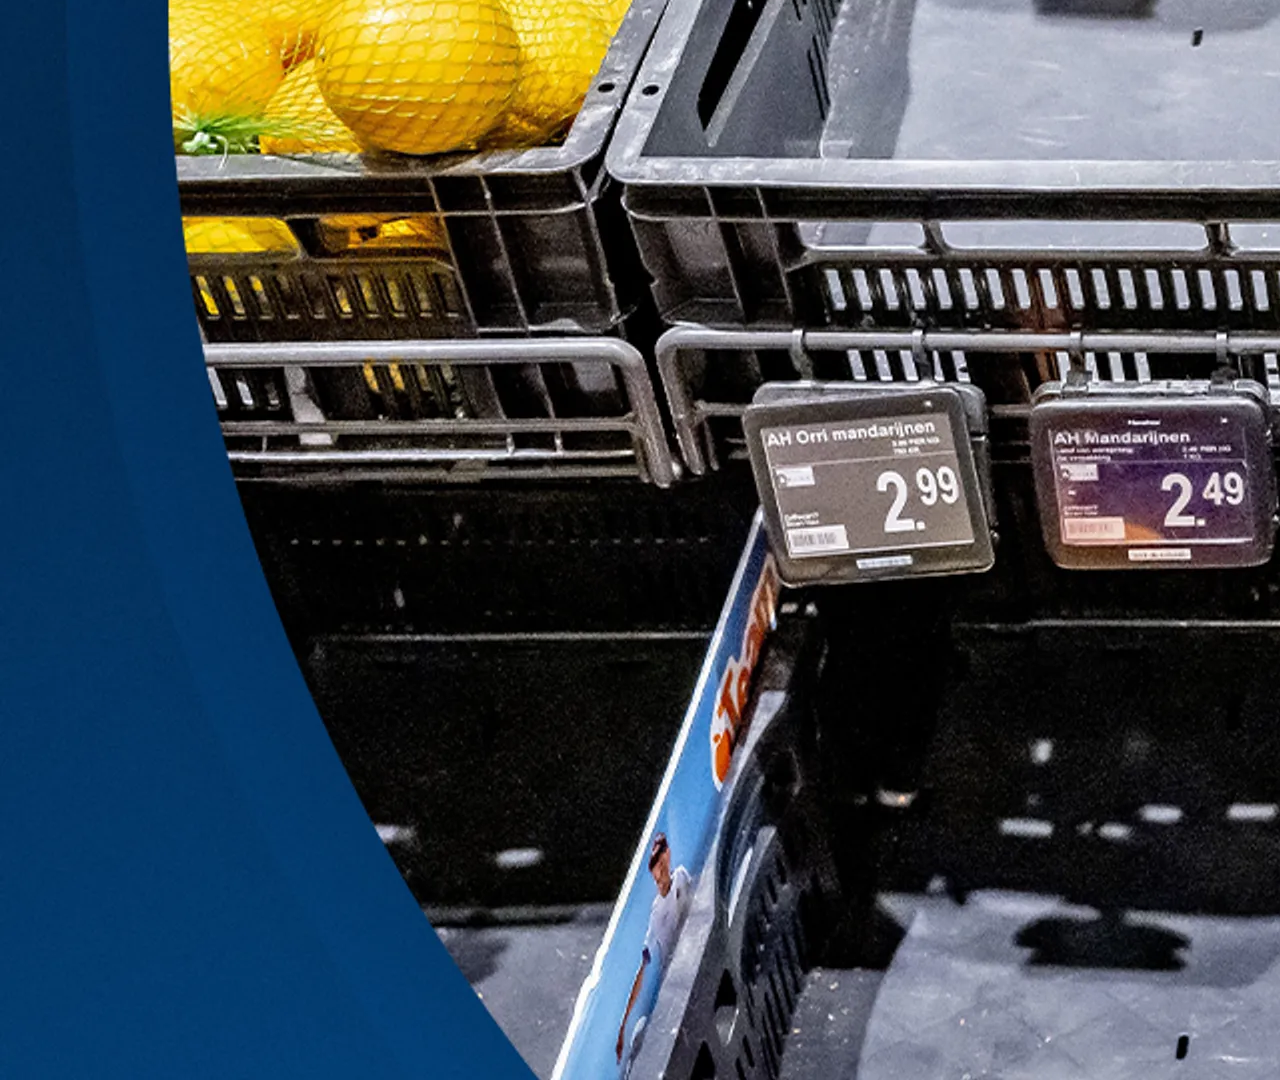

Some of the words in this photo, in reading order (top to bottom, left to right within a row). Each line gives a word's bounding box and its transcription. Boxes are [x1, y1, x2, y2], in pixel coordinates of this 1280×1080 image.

[767, 432, 791, 447] AH
[796, 430, 828, 444] Orri
[832, 422, 935, 441] mandarijnen
[1054, 433, 1079, 444] AH
[1085, 432, 1190, 445] Mandarijnen
